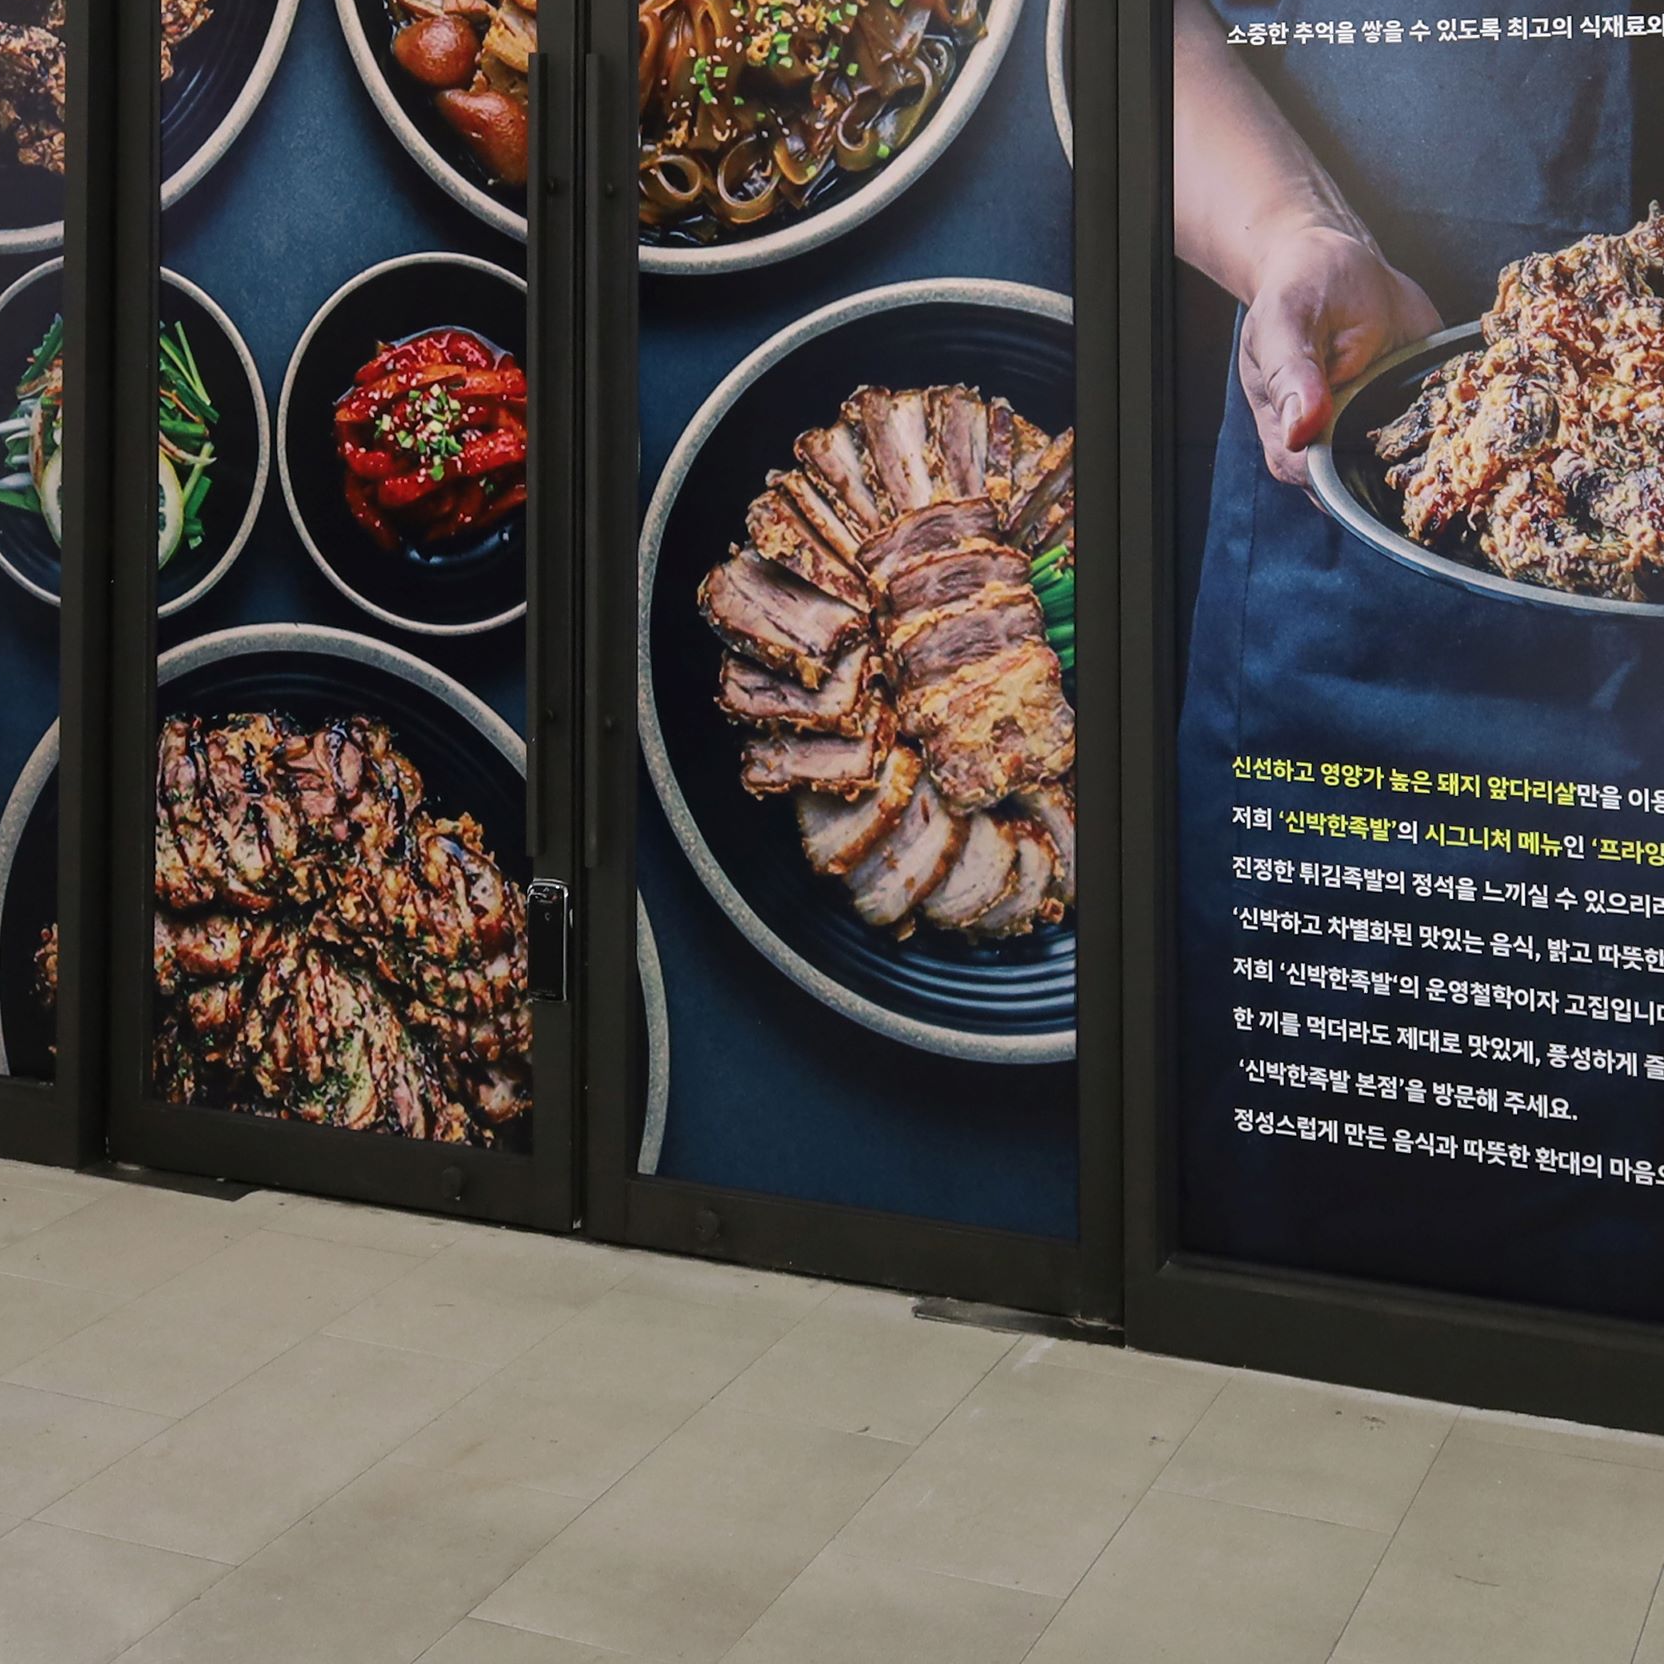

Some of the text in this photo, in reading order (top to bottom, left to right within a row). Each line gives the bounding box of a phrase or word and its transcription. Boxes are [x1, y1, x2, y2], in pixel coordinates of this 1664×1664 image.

[1226, 21, 1290, 46] 소중한
[1292, 20, 1357, 45] 추억을
[1360, 19, 1405, 44] 쌓을
[1408, 18, 1432, 43] 수
[1436, 17, 1503, 42] 있도록
[1506, 15, 1573, 41] 최고의
[1231, 755, 1316, 783] 신선하고
[1320, 762, 1385, 791] 영양가
[1388, 767, 1434, 795] 높은
[1436, 772, 1481, 799] 돼지
[1486, 776, 1623, 811] 앞다리살만을
[1231, 805, 1273, 832] 저희
[1424, 822, 1512, 854] 시그니처
[1517, 831, 1585, 860] 메뉴인
[1232, 855, 1296, 884] 진정한
[1298, 861, 1406, 895] 튀김족발의
[1411, 872, 1478, 902] 정석을
[1481, 880, 1550, 910] 느끼실
[1554, 886, 1579, 911] 수
[1327, 915, 1413, 947] 차별화된
[1418, 924, 1486, 955] 맛있는
[1488, 932, 1542, 963] 음식,
[1546, 937, 1594, 964] 밝고
[1232, 956, 1274, 983] 저희
[1424, 977, 1561, 1015] 운영철학이자
[1232, 1005, 1255, 1032] 한
[1258, 1009, 1302, 1038] 끼를
[1306, 1015, 1393, 1046] 먹더라도
[1396, 1026, 1463, 1055] 제대로
[1467, 1034, 1542, 1068] 맛있게,
[1545, 1042, 1638, 1078] 풍성하게
[1432, 1081, 1499, 1113] 방문해
[1503, 1090, 1579, 1121] 주세요.
[1233, 1107, 1339, 1144] 정성스럽게
[1343, 1122, 1388, 1151] 만든
[1391, 1128, 1459, 1160] 음식과
[1463, 1138, 1532, 1170] 따뜻한
[1534, 1146, 1603, 1180] 환대의
